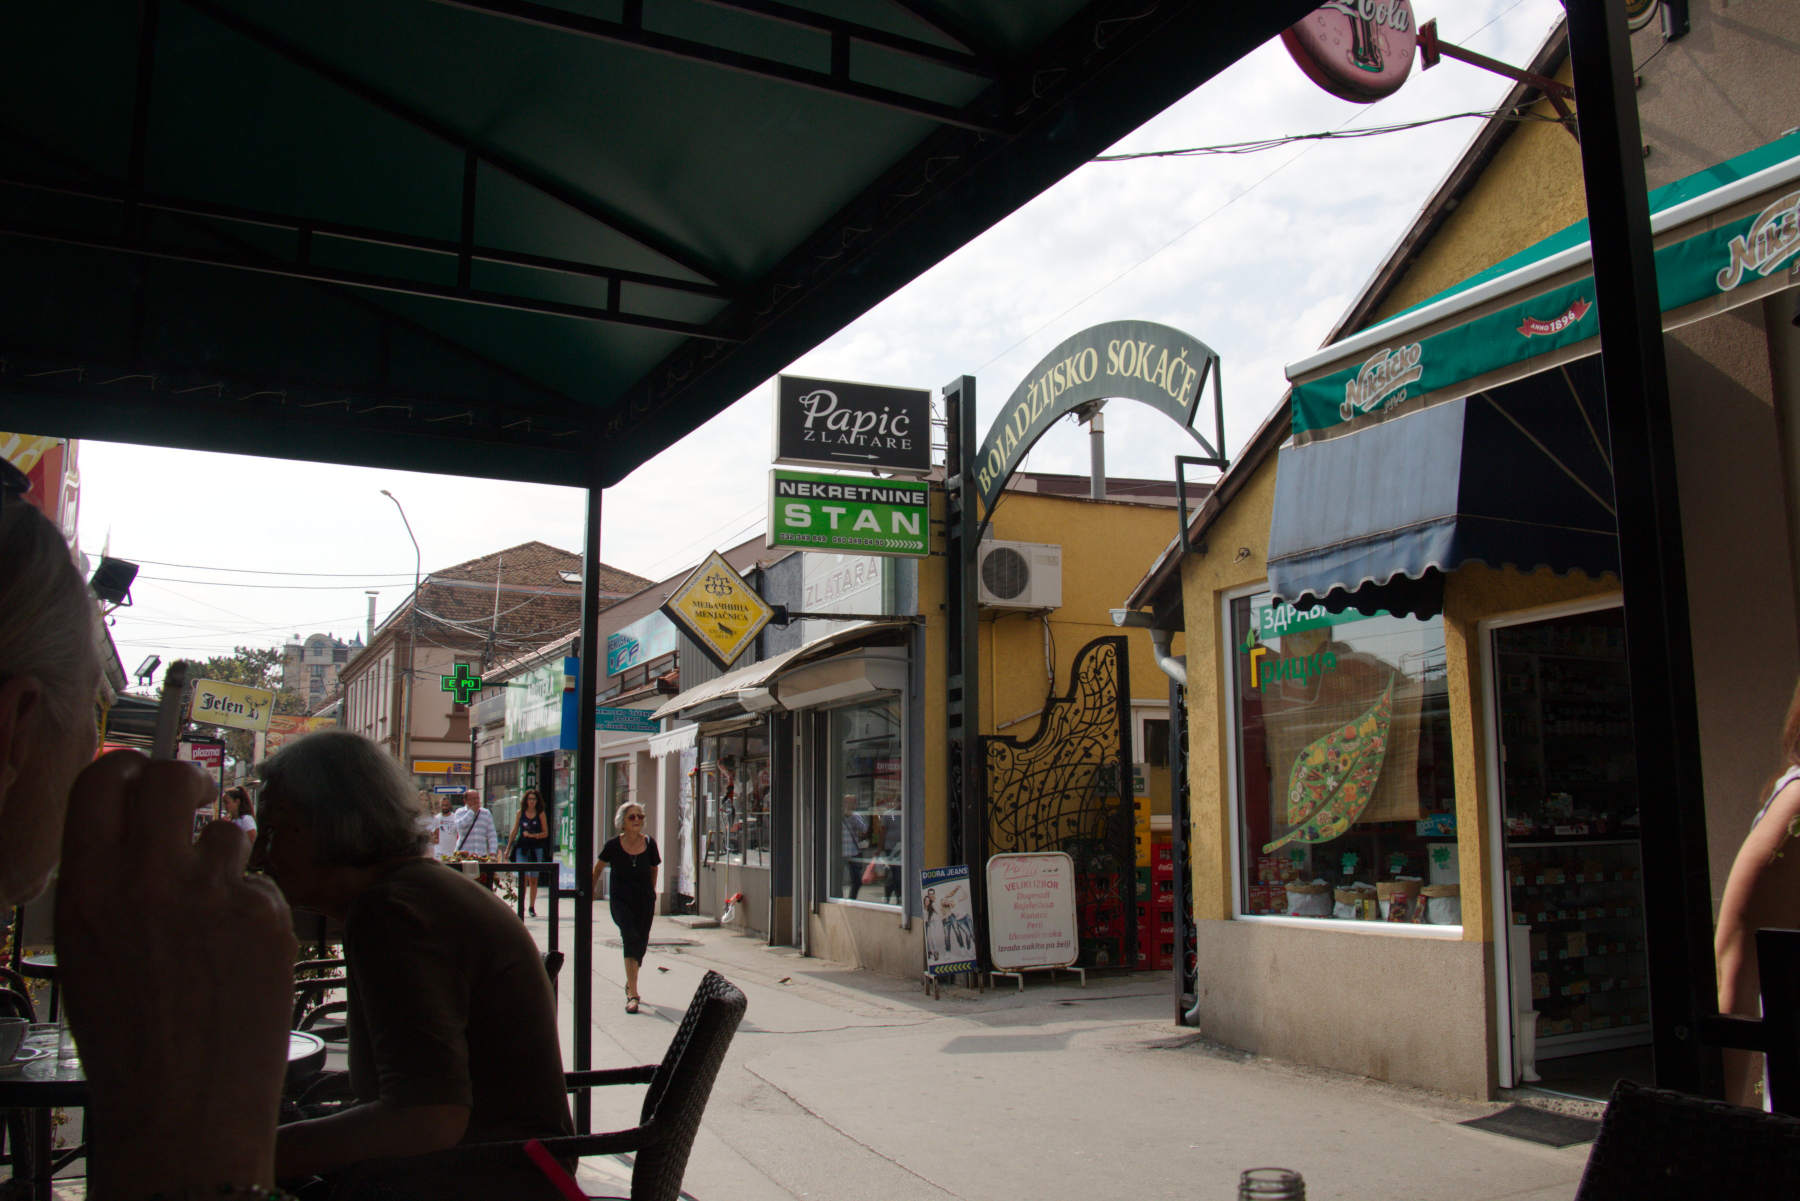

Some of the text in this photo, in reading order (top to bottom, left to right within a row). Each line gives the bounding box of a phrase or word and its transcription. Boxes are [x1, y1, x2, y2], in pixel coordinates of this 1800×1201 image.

[1530, 310, 1576, 331] ANNO 1896
[798, 389, 910, 444] Papić
[978, 340, 1197, 495] BOJADŽIJSKO SOKAČE
[804, 430, 912, 450] ZLATARE
[779, 482, 925, 504] NEKRETNINE
[784, 503, 920, 535] STAN
[805, 558, 879, 608] ZLATARA
[695, 610, 749, 621] MENJAČNICA
[200, 692, 244, 714] Jelen
[946, 866, 968, 876] JEANS
